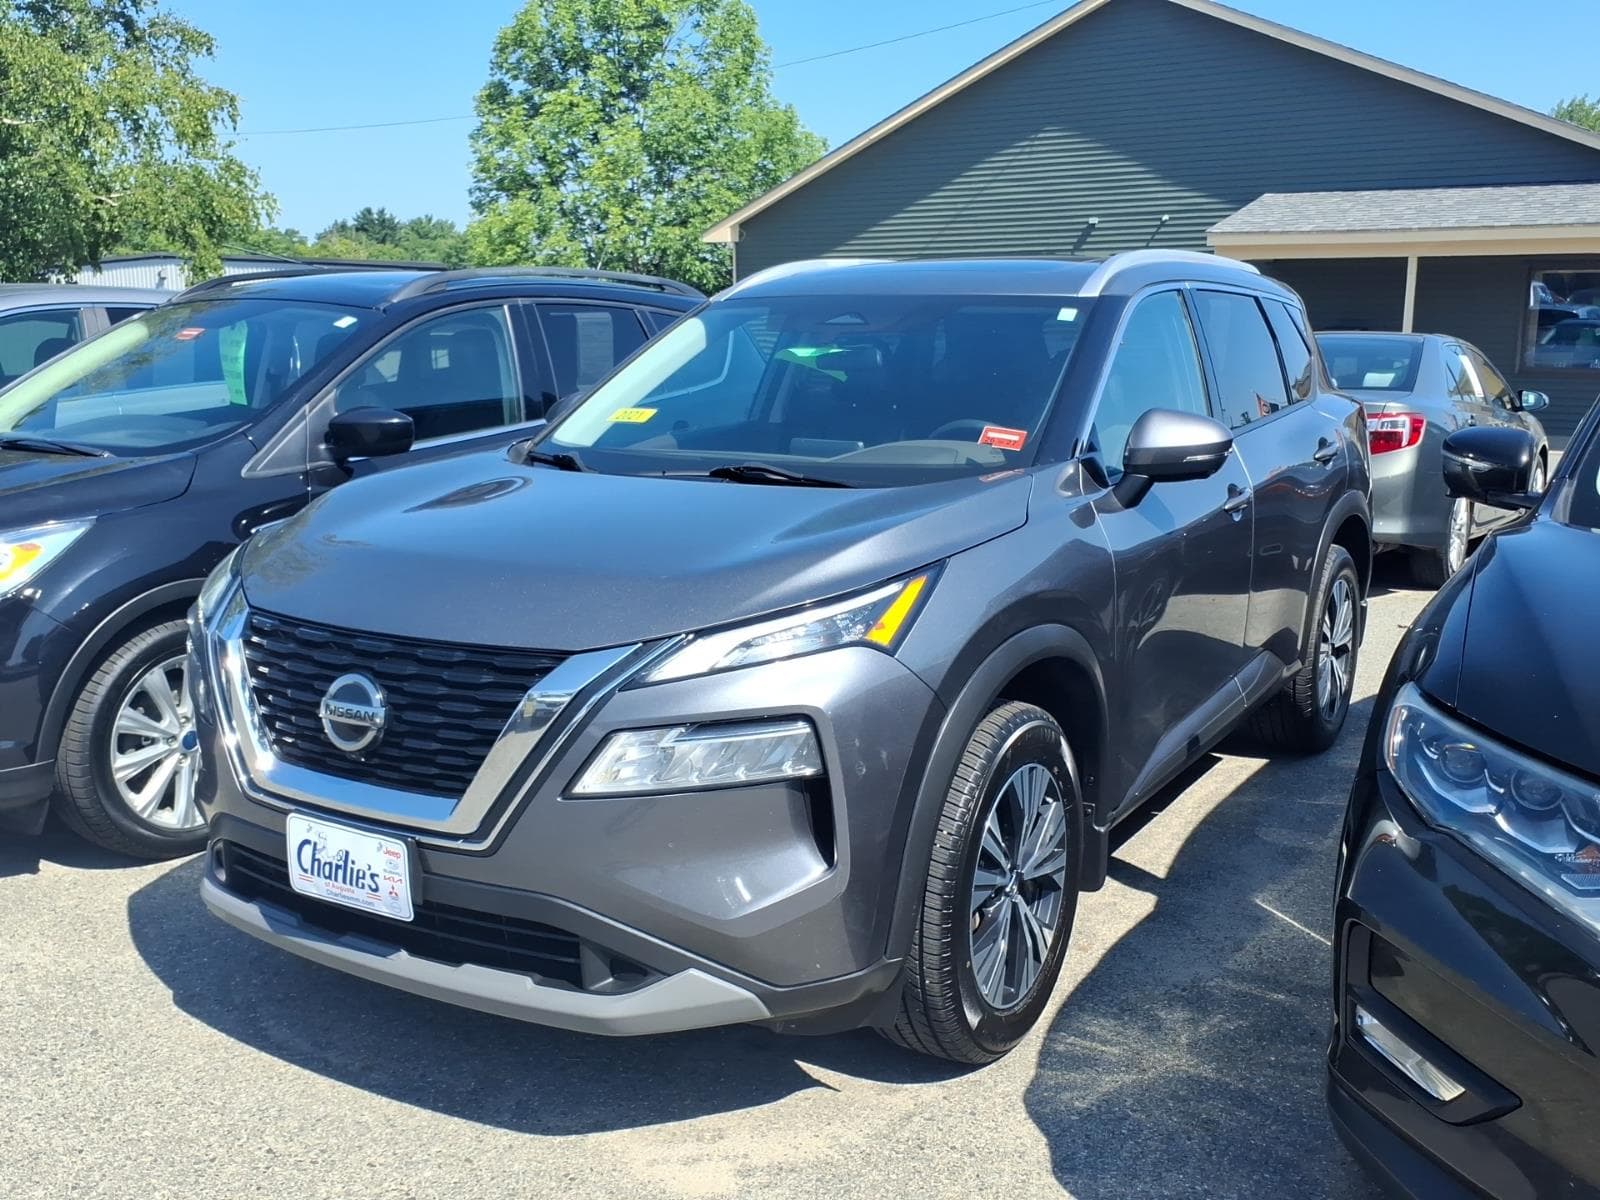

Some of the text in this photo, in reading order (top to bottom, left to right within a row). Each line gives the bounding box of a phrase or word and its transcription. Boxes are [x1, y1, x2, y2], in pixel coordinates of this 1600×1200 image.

[325, 703, 375, 722] NISSAN
[383, 847, 402, 860] Jeep
[297, 838, 380, 893] Charlie's
